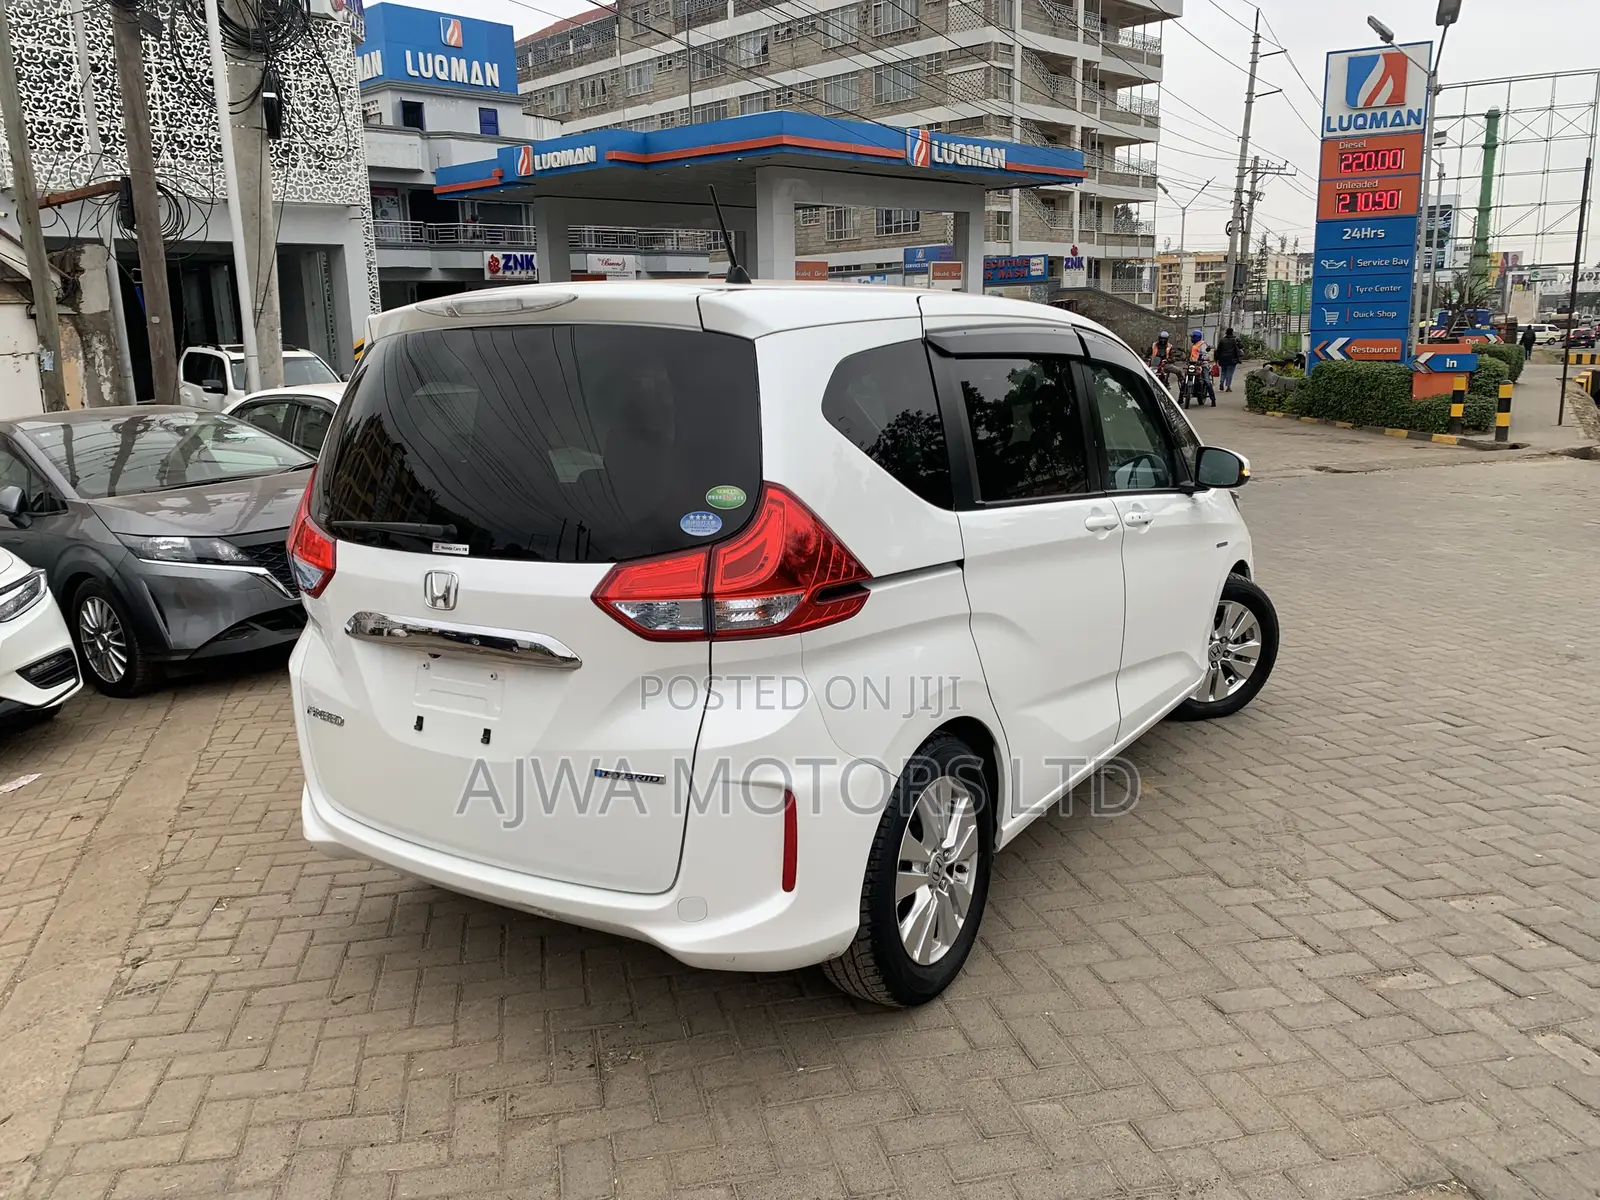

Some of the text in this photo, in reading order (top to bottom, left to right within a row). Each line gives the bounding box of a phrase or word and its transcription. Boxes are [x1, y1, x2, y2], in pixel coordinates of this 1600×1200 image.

[405, 50, 500, 88] LUQMAN
[1326, 108, 1422, 132] LUQMAN
[1339, 140, 1367, 150] Diesel
[534, 145, 597, 171] LUQMAN
[932, 140, 1006, 169] LUQMAN
[1340, 149, 1401, 173] 220.00
[1336, 180, 1378, 190] Unleaded
[1342, 228, 1385, 241] 24Hrs
[501, 254, 536, 271] ZNK
[1064, 256, 1085, 270] ZNK
[1357, 257, 1410, 267] Service Bay
[997, 269, 1028, 279] WASH
[1355, 284, 1402, 295] Tyre Center
[1353, 310, 1397, 320] Quick Shop
[1351, 345, 1398, 354] Restaurant
[1446, 358, 1457, 369] In
